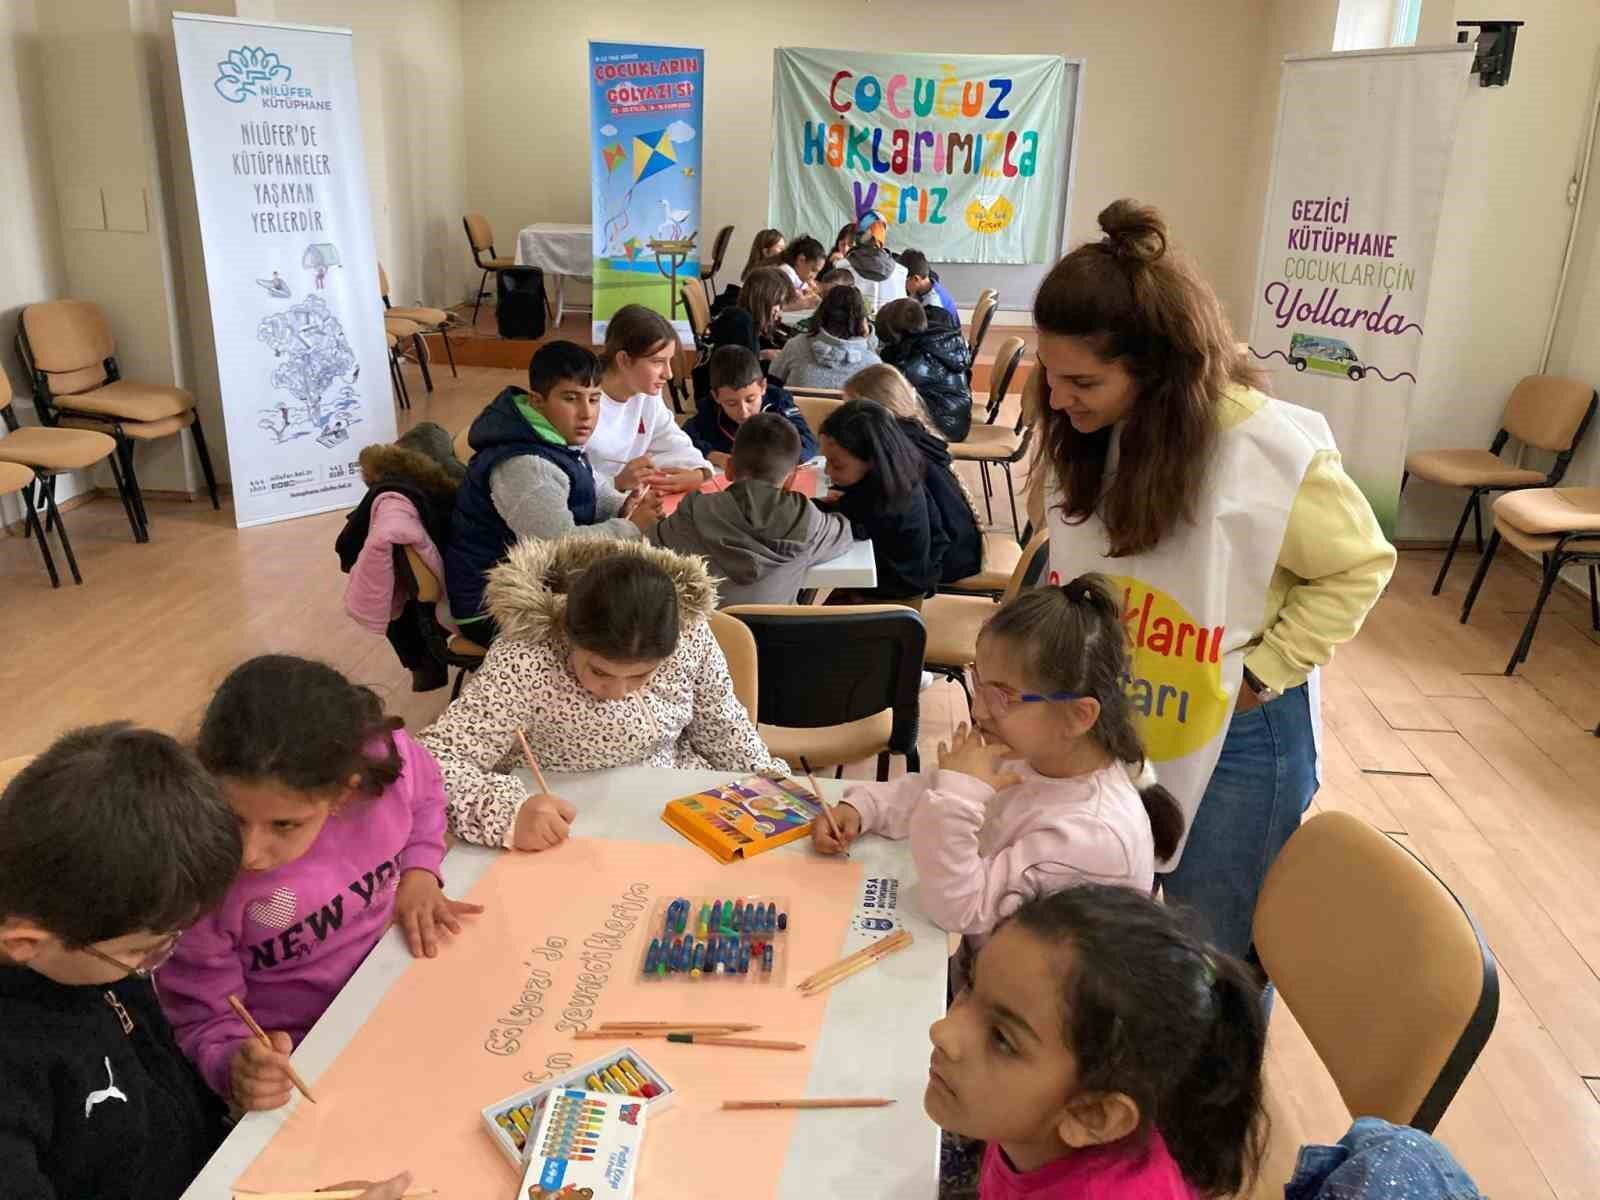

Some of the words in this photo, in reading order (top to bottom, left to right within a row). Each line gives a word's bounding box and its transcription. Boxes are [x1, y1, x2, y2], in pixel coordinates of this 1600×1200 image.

[259, 83, 313, 99] NİLÜFER
[262, 97, 333, 112] KÜTÜPHANE
[828, 64, 1013, 121] ÇOCUĞUZ
[240, 120, 318, 147] NİLÜFER'DE
[231, 151, 332, 177] KÜTÜPHANELER
[253, 182, 315, 208] YAŞAYAN
[250, 210, 323, 234] YERLERDİR
[1291, 196, 1350, 224] GEZİCİ
[1287, 225, 1398, 259] KÜTÜPHANE
[1283, 256, 1375, 287] ÇOCUKLAR
[1264, 281, 1423, 336] Yollarda
[863, 878, 879, 908] BURSA
[249, 893, 344, 972] NEW
